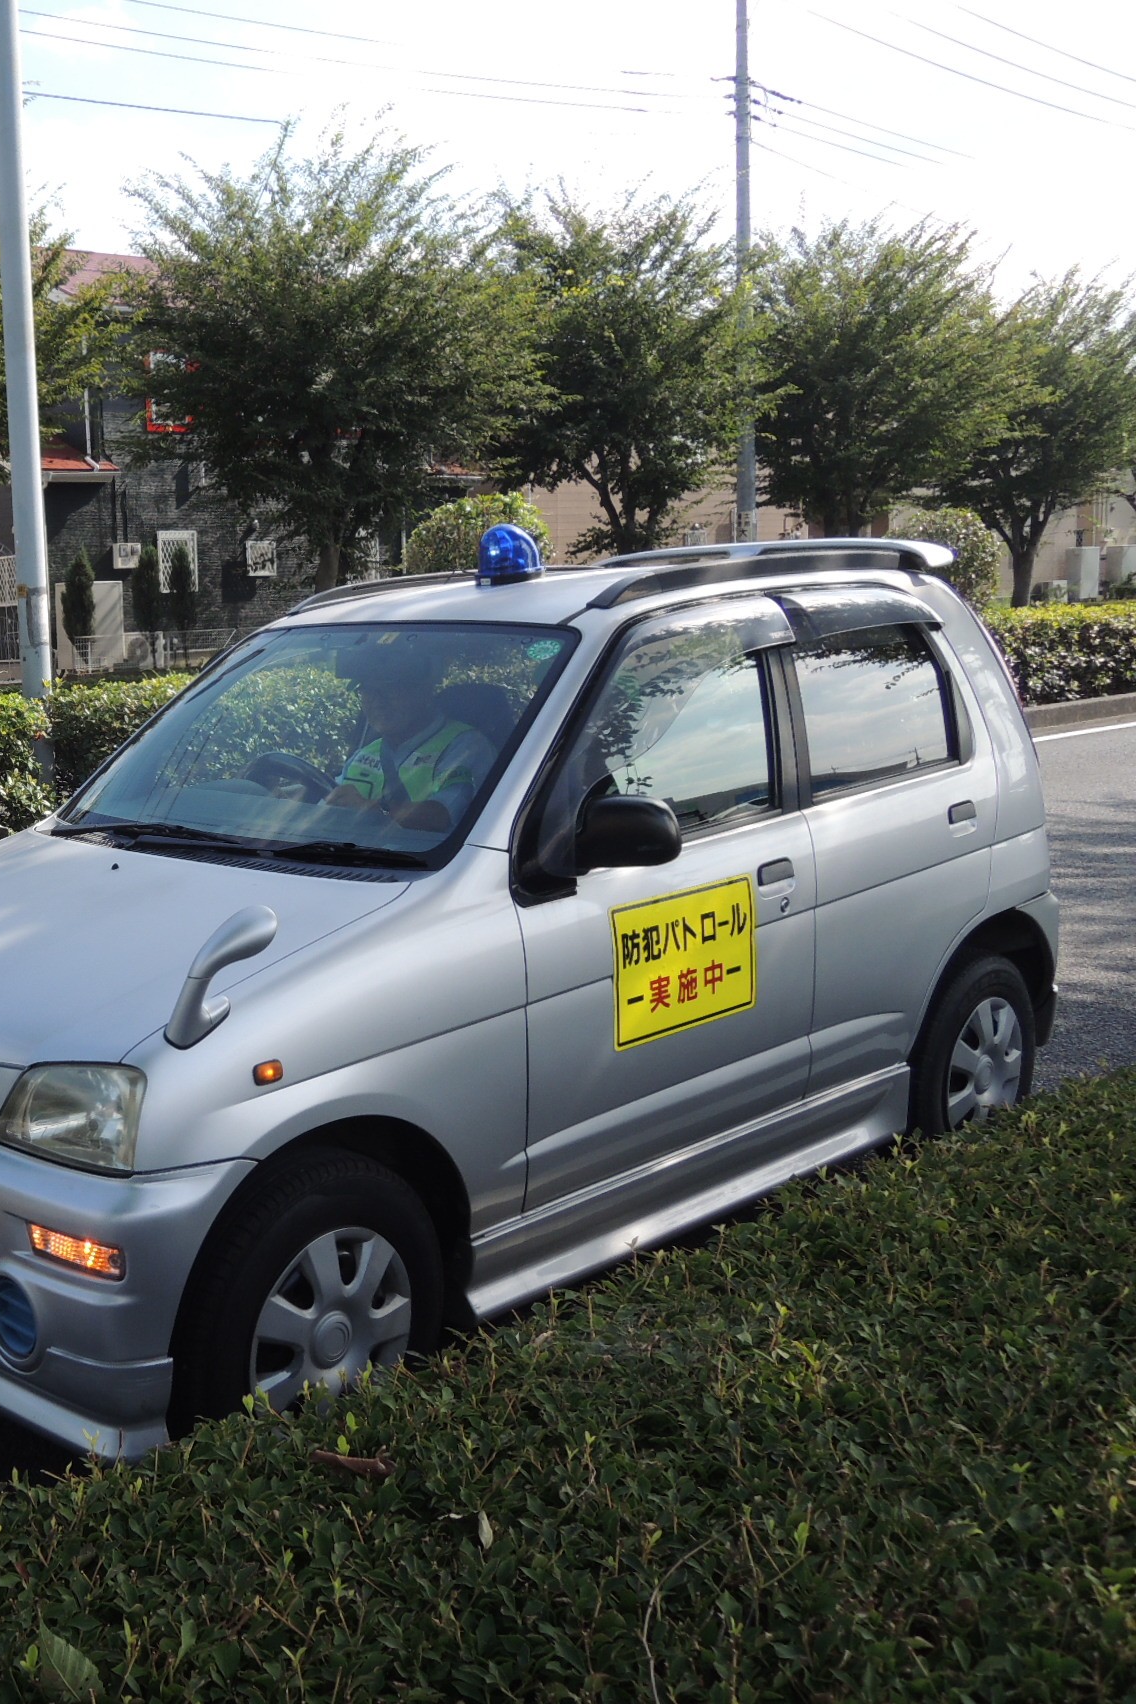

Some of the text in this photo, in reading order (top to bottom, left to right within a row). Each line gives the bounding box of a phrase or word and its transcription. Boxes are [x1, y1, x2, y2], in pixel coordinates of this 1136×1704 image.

[621, 902, 748, 969] 防犯パトロール
